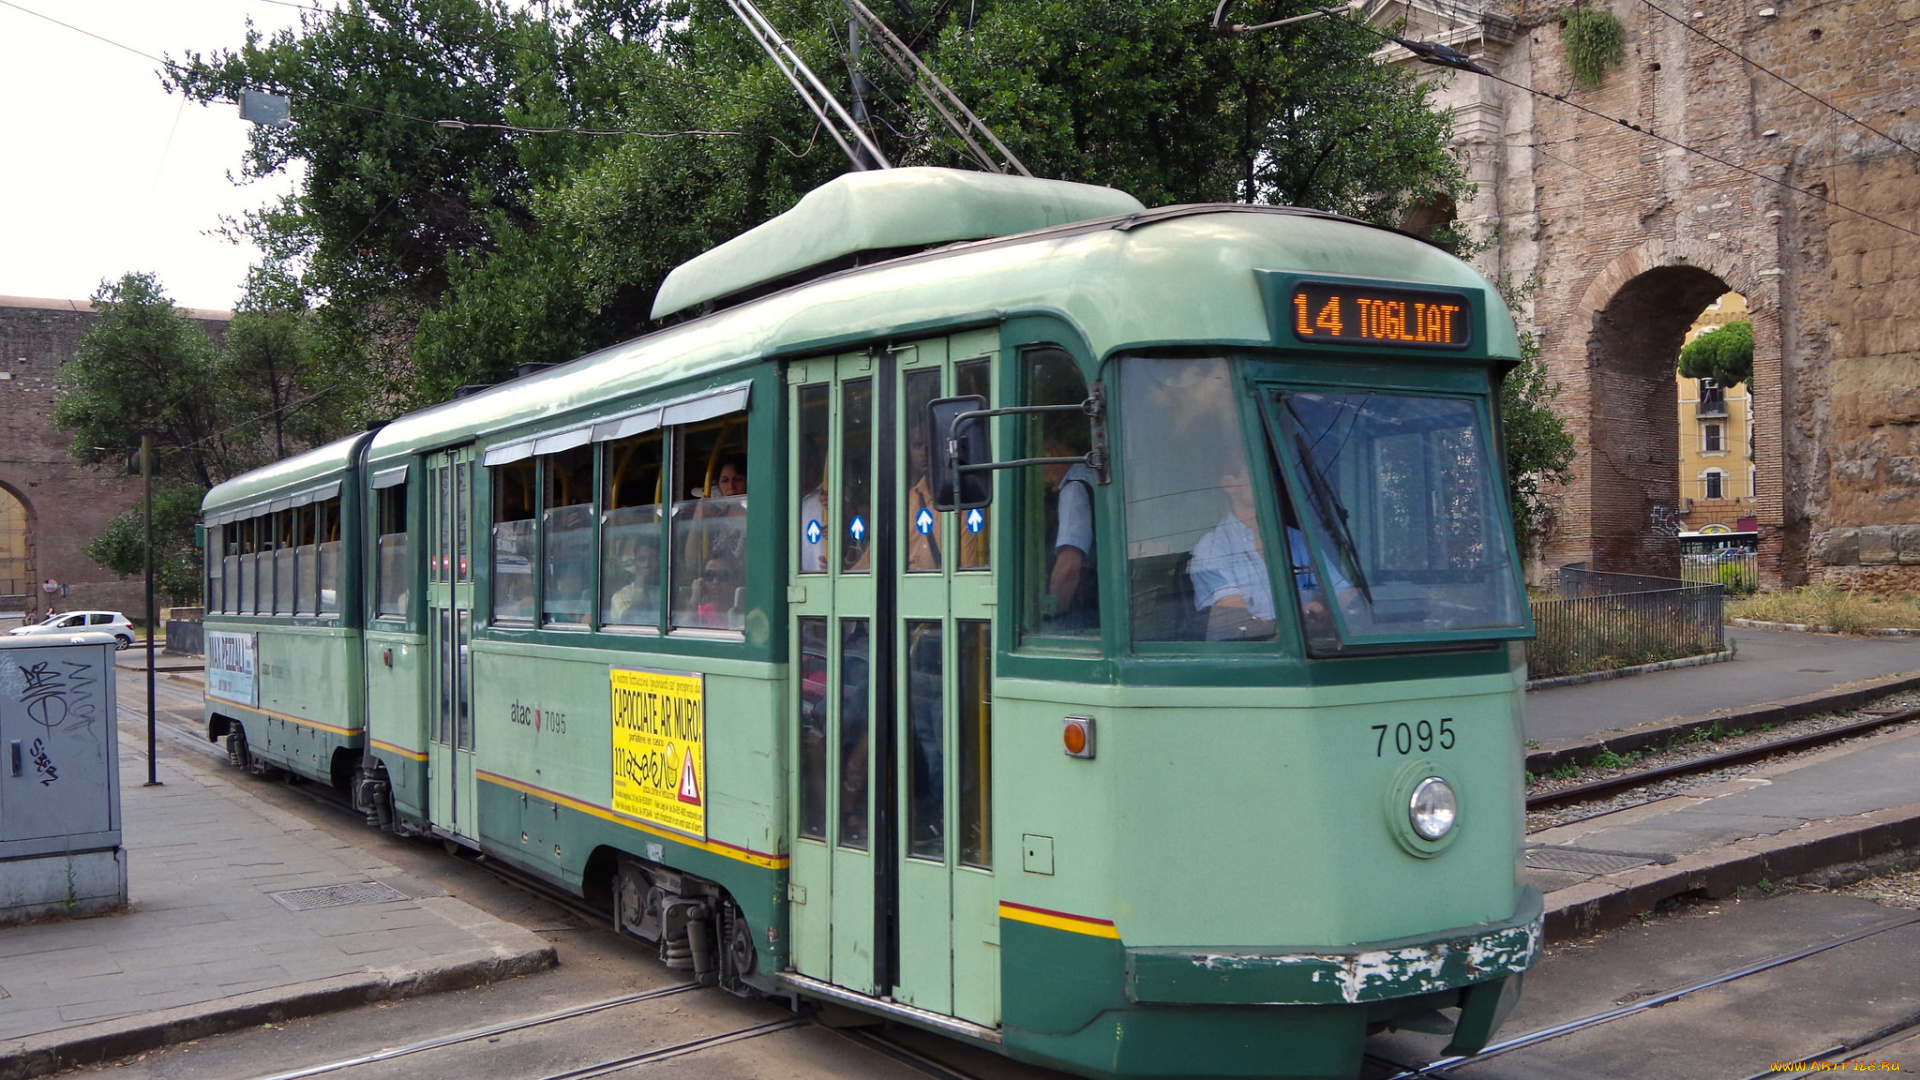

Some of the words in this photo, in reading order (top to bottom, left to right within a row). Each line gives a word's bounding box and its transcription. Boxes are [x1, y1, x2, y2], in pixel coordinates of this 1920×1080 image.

[511, 699, 531, 726] atac
[545, 711, 566, 735] 7095
[614, 688, 658, 735] CAPOCCIATE
[661, 695, 672, 738] AR
[674, 697, 701, 743] MURO!
[1371, 718, 1455, 758] 7095
